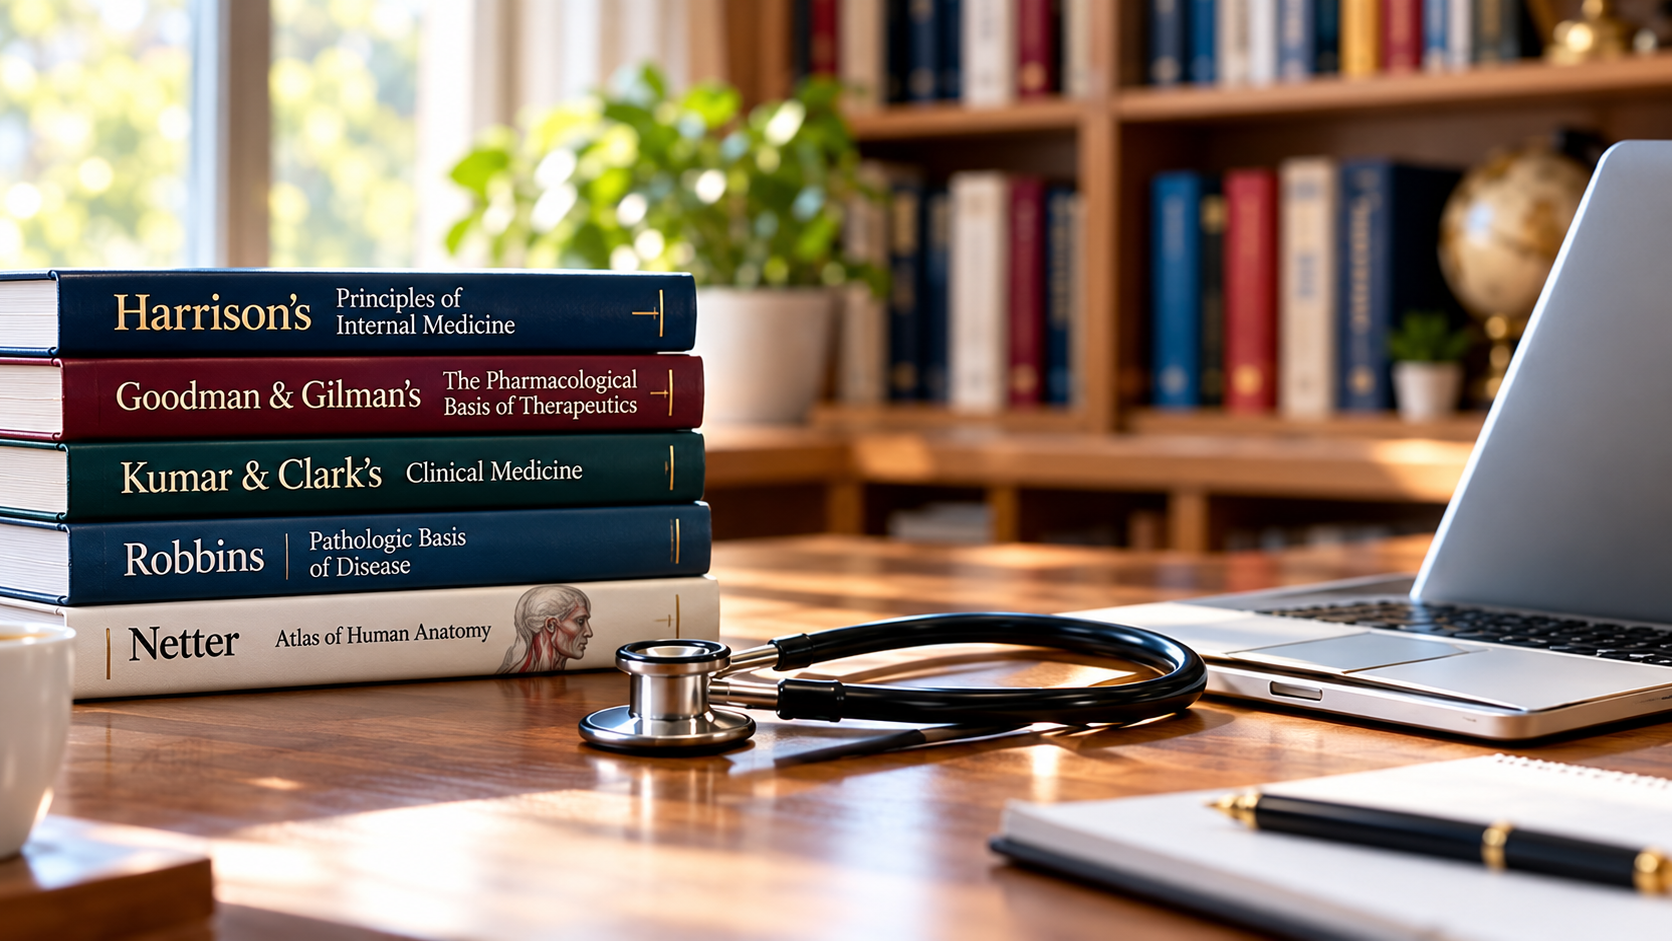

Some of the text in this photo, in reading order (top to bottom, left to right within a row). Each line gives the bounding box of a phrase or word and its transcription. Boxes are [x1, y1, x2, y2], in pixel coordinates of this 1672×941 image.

[113, 293, 312, 331] Harrison's
[336, 286, 464, 314] Principles of
[336, 313, 516, 335] Internal Medicine
[116, 378, 422, 411] Goodman & Gilman's
[442, 368, 638, 393] The Pharmacological
[443, 394, 638, 420] Basis of Therapeutics
[120, 455, 383, 494] Kumar & Clark's
[406, 458, 583, 484] Clinical Medicine
[309, 526, 467, 554] Pathologic Basis
[123, 538, 265, 577] Robbins
[309, 555, 411, 578] of Disease
[127, 626, 240, 662] Netter
[274, 622, 492, 648] Atlas of Human Anatomy
